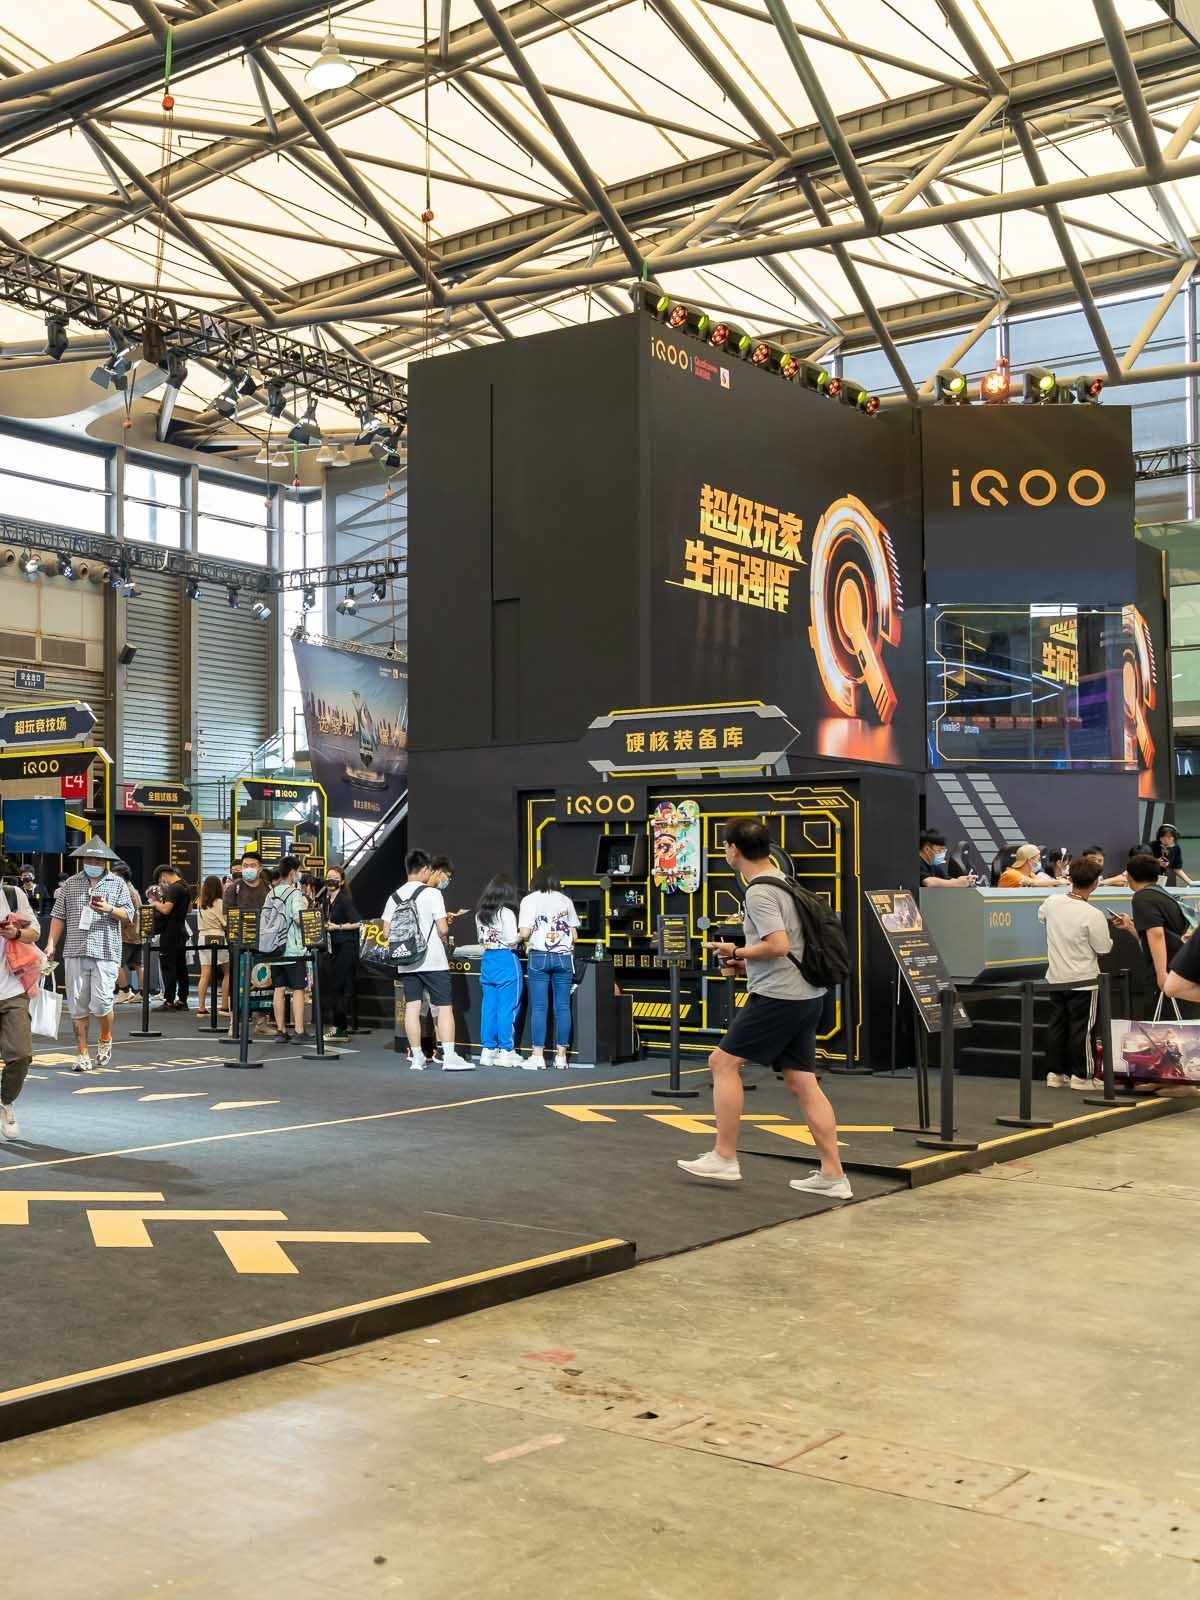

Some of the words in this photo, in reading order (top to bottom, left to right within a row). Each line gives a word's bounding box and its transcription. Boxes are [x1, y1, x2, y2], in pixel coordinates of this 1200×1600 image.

[651, 337, 688, 370] iQOO
[952, 469, 1106, 507] iQOO
[700, 483, 808, 566] 超级玩家
[665, 539, 799, 614] 生而强悍
[14, 716, 67, 735] 超玩竞技场
[626, 726, 744, 753] 硬核装备库
[23, 760, 60, 775] iQOO
[567, 794, 635, 815] iQOO
